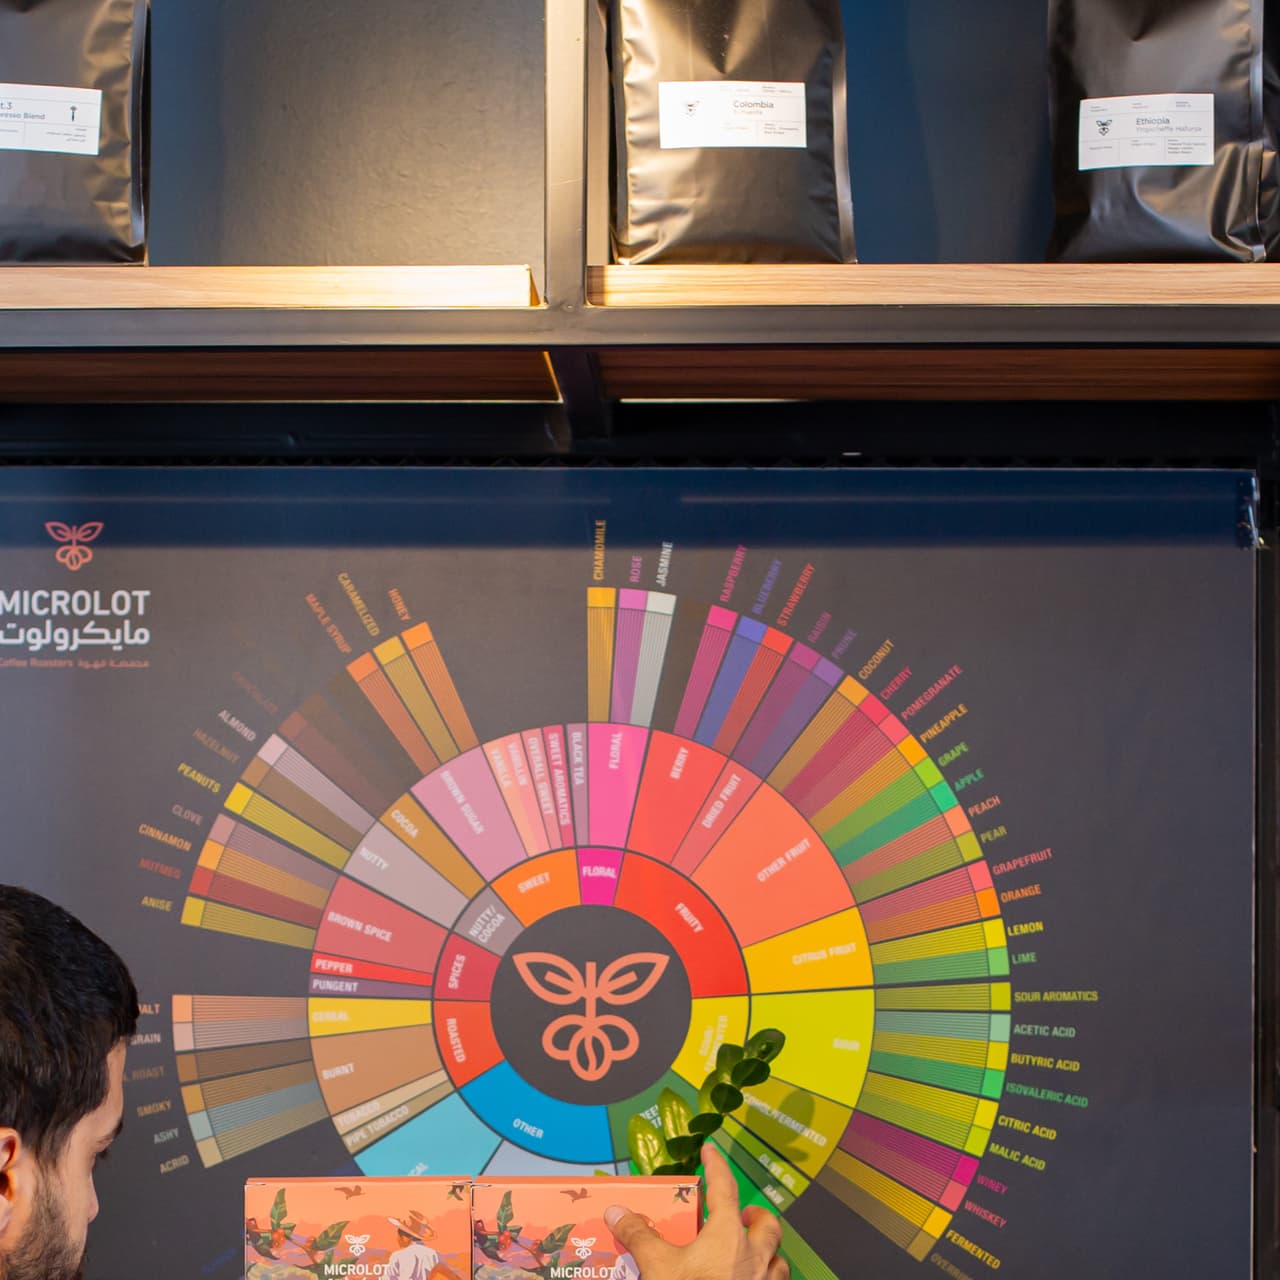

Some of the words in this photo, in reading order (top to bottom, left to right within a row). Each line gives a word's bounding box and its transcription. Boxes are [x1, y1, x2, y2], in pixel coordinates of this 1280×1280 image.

[23, 112, 46, 120] Blend
[733, 100, 774, 109] Colombia
[1135, 117, 1171, 126] Ethiopia
[592, 519, 607, 580] CHAMOMILE
[629, 555, 642, 583] ROSE
[655, 541, 673, 587] JASMINE
[720, 545, 748, 603] RASPBERRY
[752, 558, 782, 616] BLUEBERRY
[776, 562, 816, 628] STRAWBERRY
[337, 572, 380, 637] CARAMELIZED
[387, 587, 412, 622] HONEY
[305, 593, 331, 627] MAPLE
[325, 623, 352, 655] SYRUP
[30, 658, 73, 668] Roasters
[858, 638, 895, 680] COCONUT
[879, 665, 913, 701] CHERRY
[900, 663, 964, 721] POMEGRANATE
[218, 709, 257, 742] ALMOND
[919, 702, 969, 744] PINEAPPLE
[608, 731, 623, 770] FLORAL
[670, 746, 689, 780] BERRY
[937, 741, 969, 768] GRAPE
[177, 762, 222, 793] PEANUTS
[953, 768, 985, 792] APPLE
[171, 804, 203, 826] CLOVE
[439, 769, 466, 805] BROWN
[459, 801, 485, 835] SUGAR
[701, 794, 725, 830] DRIED
[720, 773, 742, 801] FRUIT
[968, 795, 1001, 818] PEACH
[137, 823, 192, 852] CINNAMON
[390, 808, 420, 839] COCOA
[980, 825, 1008, 844] PEAR
[138, 857, 182, 880] NUTMEG
[359, 846, 390, 871] NUTTY
[582, 865, 617, 880] FLORAL
[756, 856, 787, 882] OTHER
[784, 837, 811, 862] FRUIT
[992, 847, 1053, 876] GRAPEFRUIT
[517, 871, 552, 894] SWEET
[1000, 884, 1042, 904] ORANGE
[141, 896, 173, 912] ANISE
[673, 902, 705, 934] FRUITY
[326, 910, 363, 934] BROWN
[363, 923, 393, 943] SPICE
[467, 904, 497, 938] NUTTY/
[477, 913, 507, 944] COCOA
[1007, 921, 1044, 936] LEMON
[314, 957, 354, 974] PEPPER
[448, 953, 467, 990] SPICES
[1011, 952, 1037, 965] LIME
[312, 978, 359, 993] PUNGENT
[1014, 991, 1041, 1002] SOUR
[1042, 991, 1099, 1002] AROMATICS
[446, 1018, 466, 1063] ROASTED
[1013, 1024, 1050, 1036] ACETIC
[1051, 1026, 1076, 1038] ACID
[322, 1062, 356, 1081] BURNT
[1010, 1052, 1054, 1069] BUTYRIC
[1056, 1059, 1080, 1072] ACID
[136, 1100, 172, 1118] SMOKY
[1006, 1081, 1064, 1104] ISOVALERIC
[1065, 1094, 1089, 1109] ACID
[153, 1127, 180, 1145] ASHY
[345, 1126, 370, 1147] PIPE
[369, 1104, 410, 1135] TOBACCO
[512, 1117, 545, 1140] OTHER
[997, 1114, 1031, 1134] CITRIC
[1032, 1124, 1057, 1141] ACID
[159, 1155, 190, 1174] ACRID
[757, 1153, 782, 1178] OLIVE
[989, 1142, 1021, 1163] MALIC
[1021, 1154, 1046, 1172] ACID
[762, 1183, 785, 1205] RAW
[977, 1174, 1009, 1196] WINEY
[964, 1199, 1008, 1230] WHISKEY
[944, 1229, 1001, 1271] FERMENTED
[324, 1263, 389, 1276] MICROLOT
[550, 1266, 616, 1279] MICROLOT
